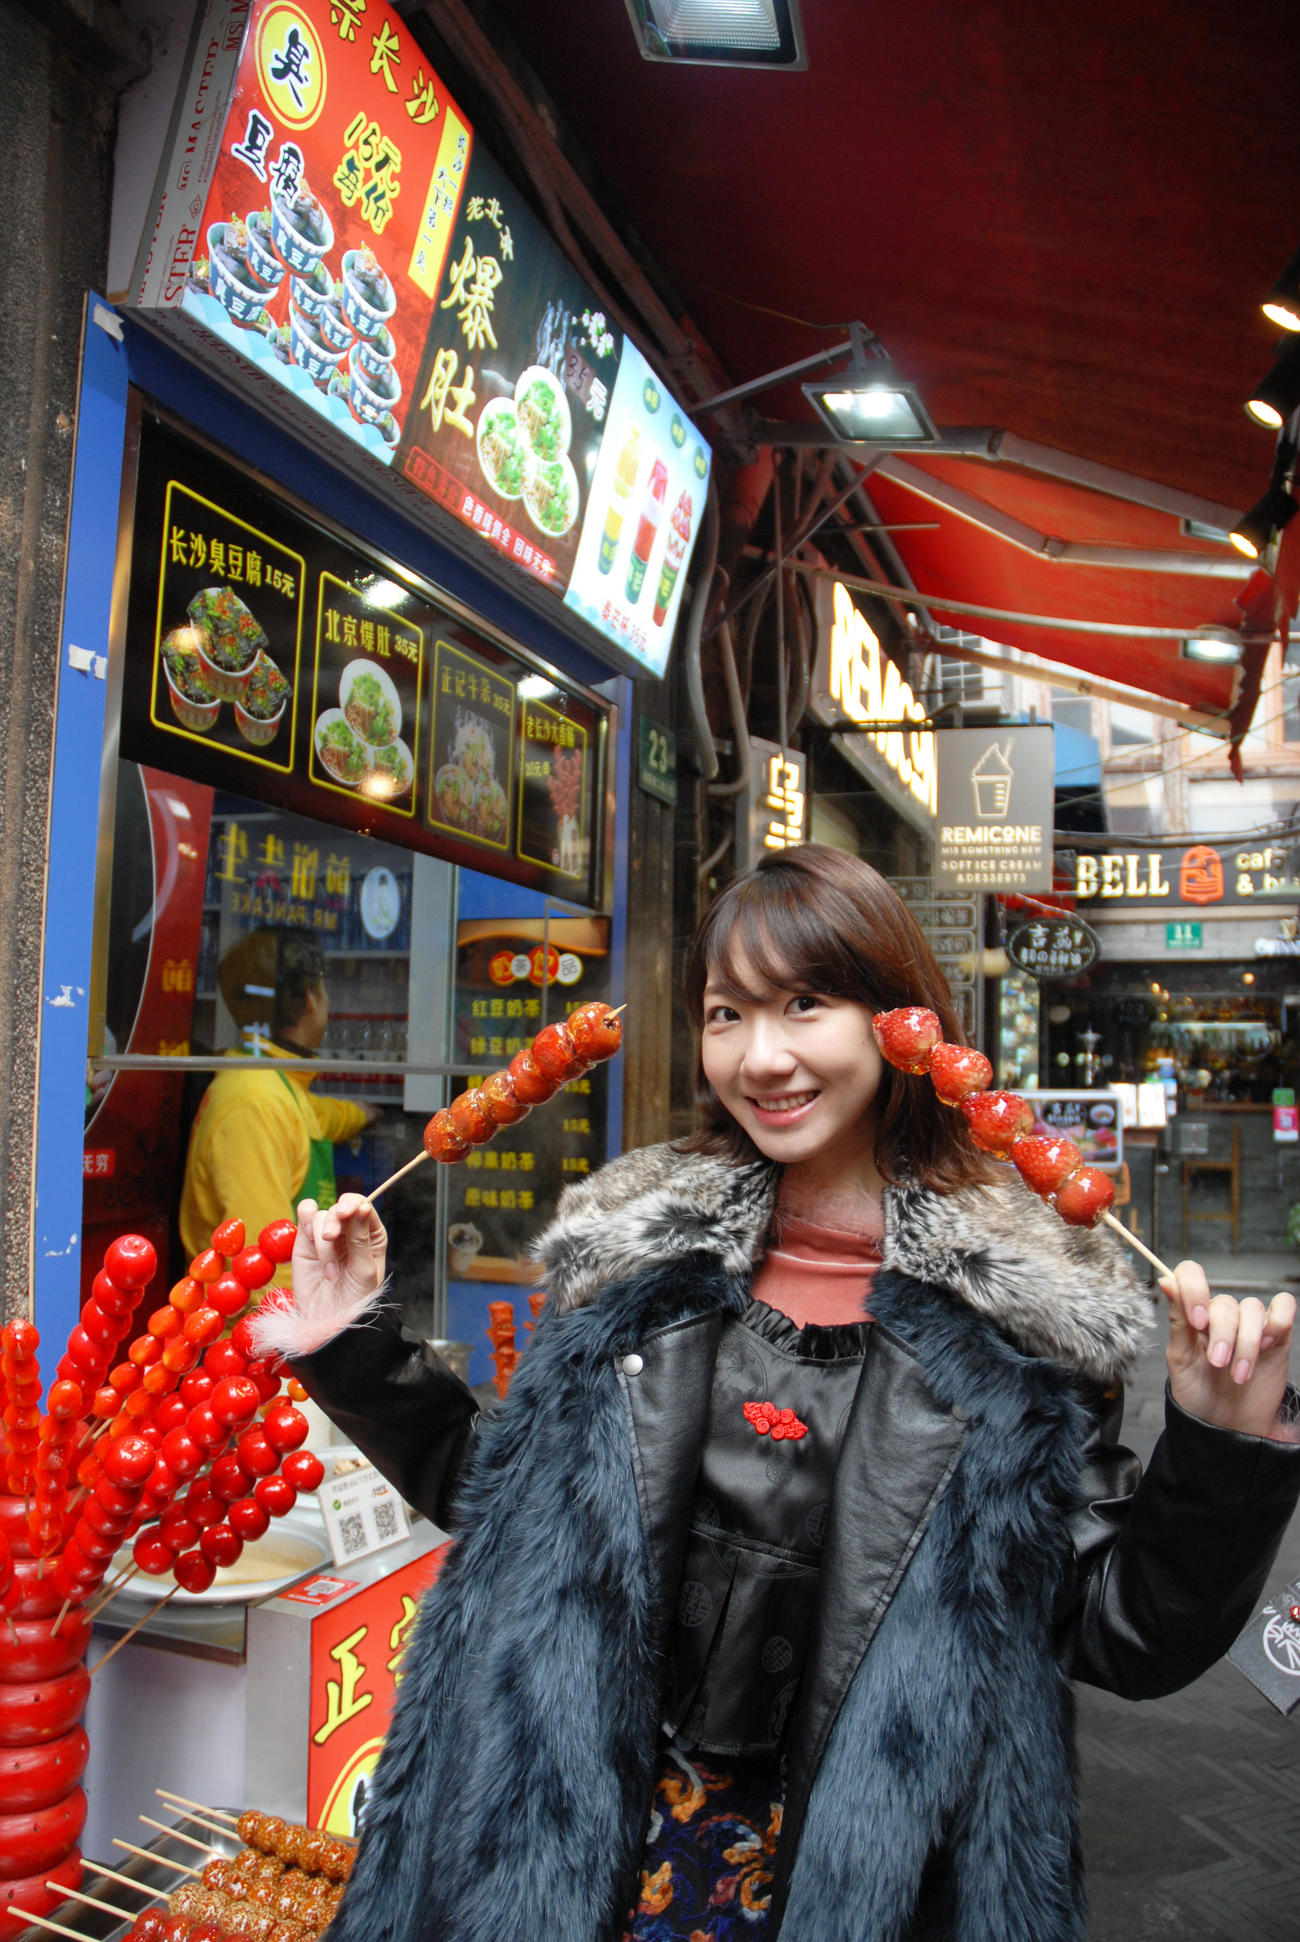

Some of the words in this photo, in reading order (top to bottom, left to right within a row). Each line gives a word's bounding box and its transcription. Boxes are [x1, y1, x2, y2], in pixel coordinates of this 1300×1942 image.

[462, 495, 512, 548] 色香味俱全
[169, 525, 263, 588] 长沙臭豆腐
[264, 564, 297, 600] 15元
[325, 608, 392, 657] 北京爆肚
[393, 634, 419, 664] 35元
[941, 825, 1043, 844] REMICONE
[961, 845, 1019, 855] SOMETHING
[941, 859, 973, 871] SOFT
[975, 859, 996, 871] ICE
[999, 859, 1043, 871] CREAM
[1075, 853, 1171, 898] BELL
[1173, 924, 1194, 939] 11
[471, 998, 541, 1018] 红豆奶茶
